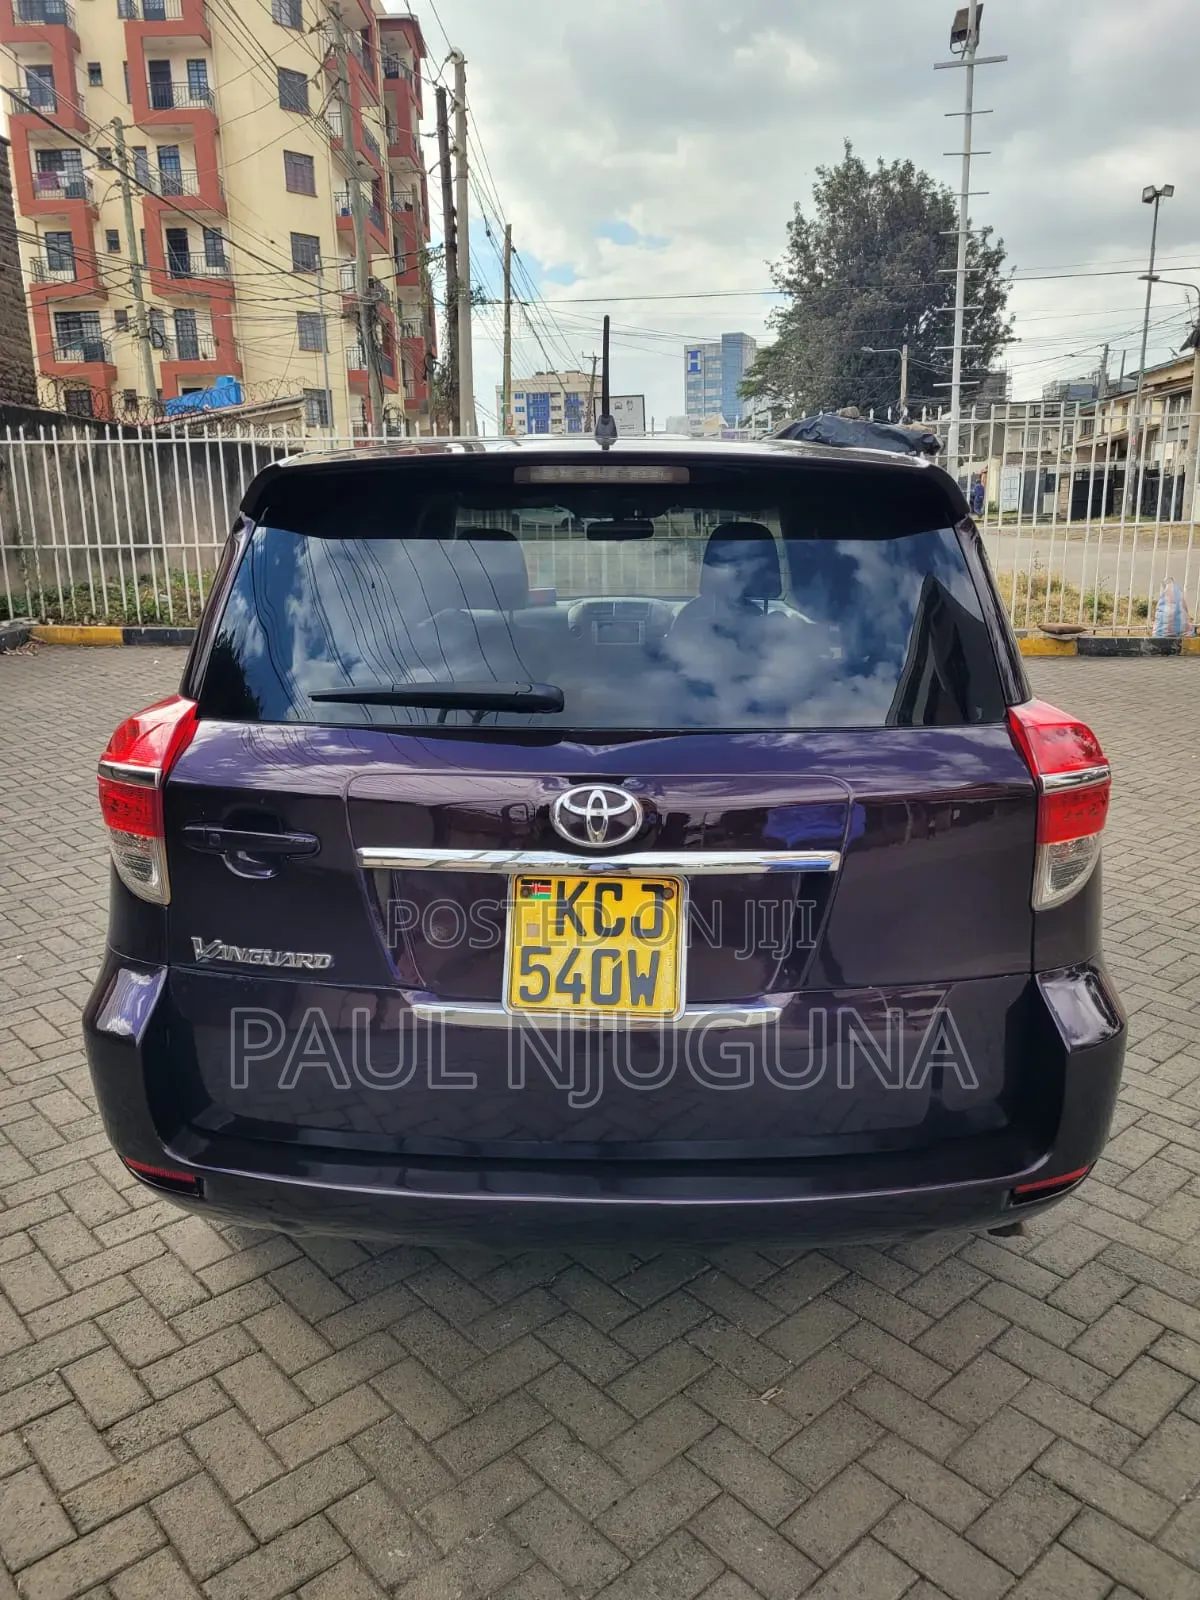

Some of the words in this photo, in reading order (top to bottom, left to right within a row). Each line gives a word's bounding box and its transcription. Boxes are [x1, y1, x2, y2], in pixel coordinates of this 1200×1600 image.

[554, 880, 666, 938] KCJ
[190, 936, 332, 969] VANGUARD
[519, 945, 661, 1007] 540W
